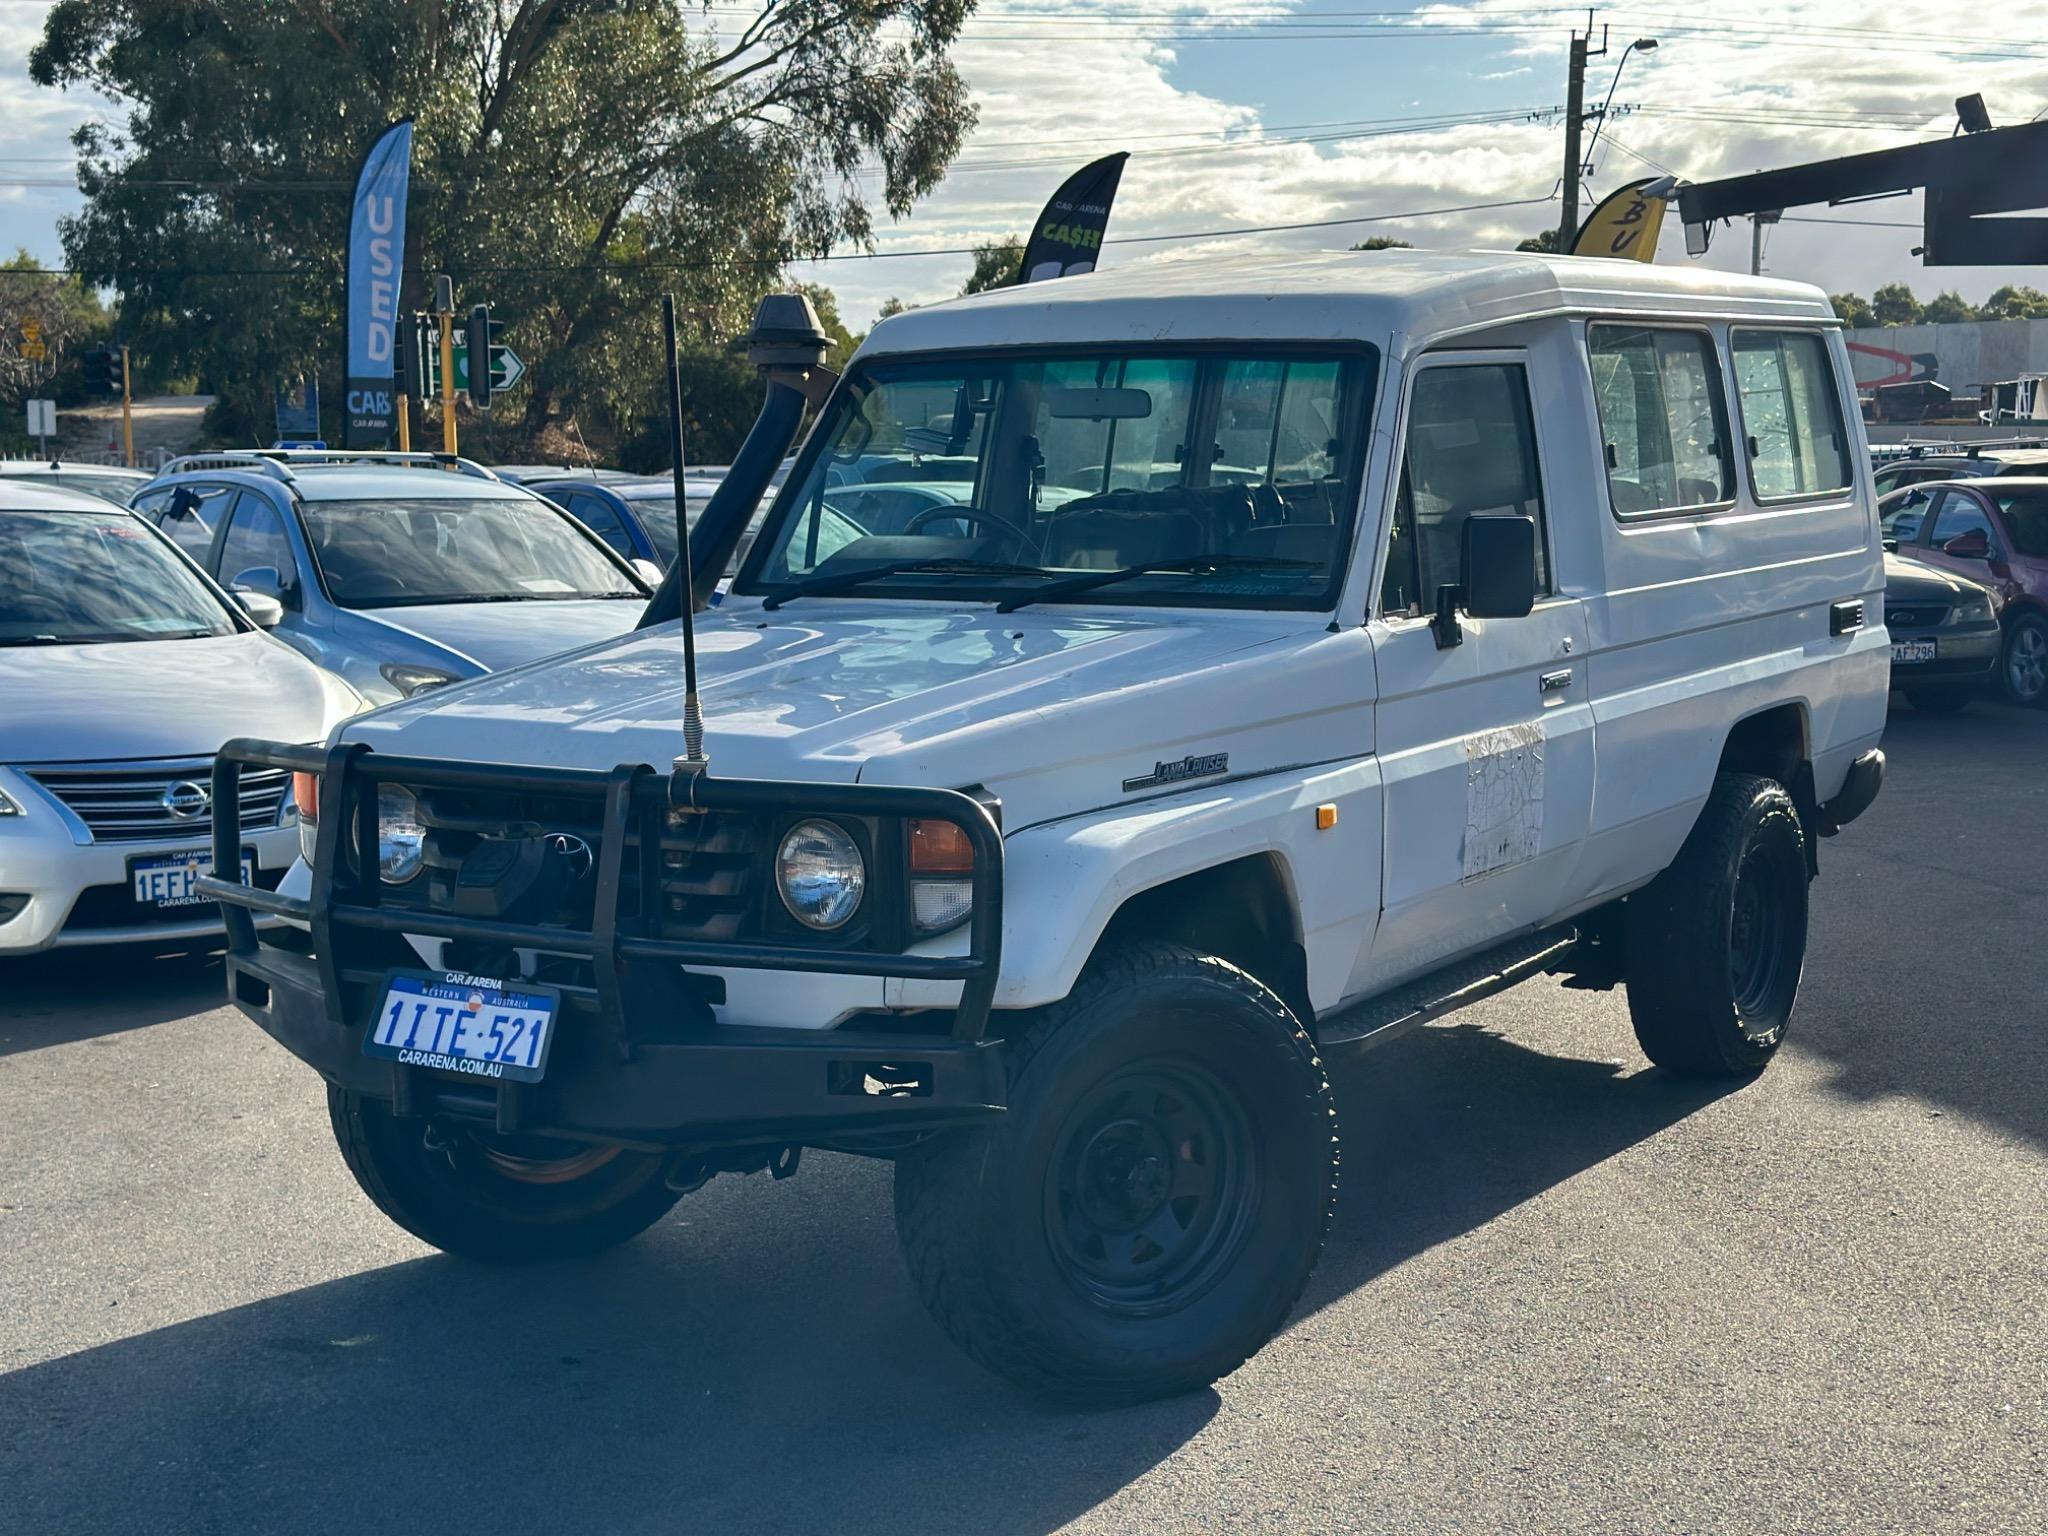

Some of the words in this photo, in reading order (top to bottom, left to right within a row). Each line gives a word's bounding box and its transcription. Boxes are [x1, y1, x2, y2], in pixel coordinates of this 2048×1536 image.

[367, 194, 393, 362] USED
[421, 987, 461, 1000] WESTERN
[491, 996, 530, 1009] AUSTRALIA
[398, 1049, 503, 1078] CARARENA.COM.AU
